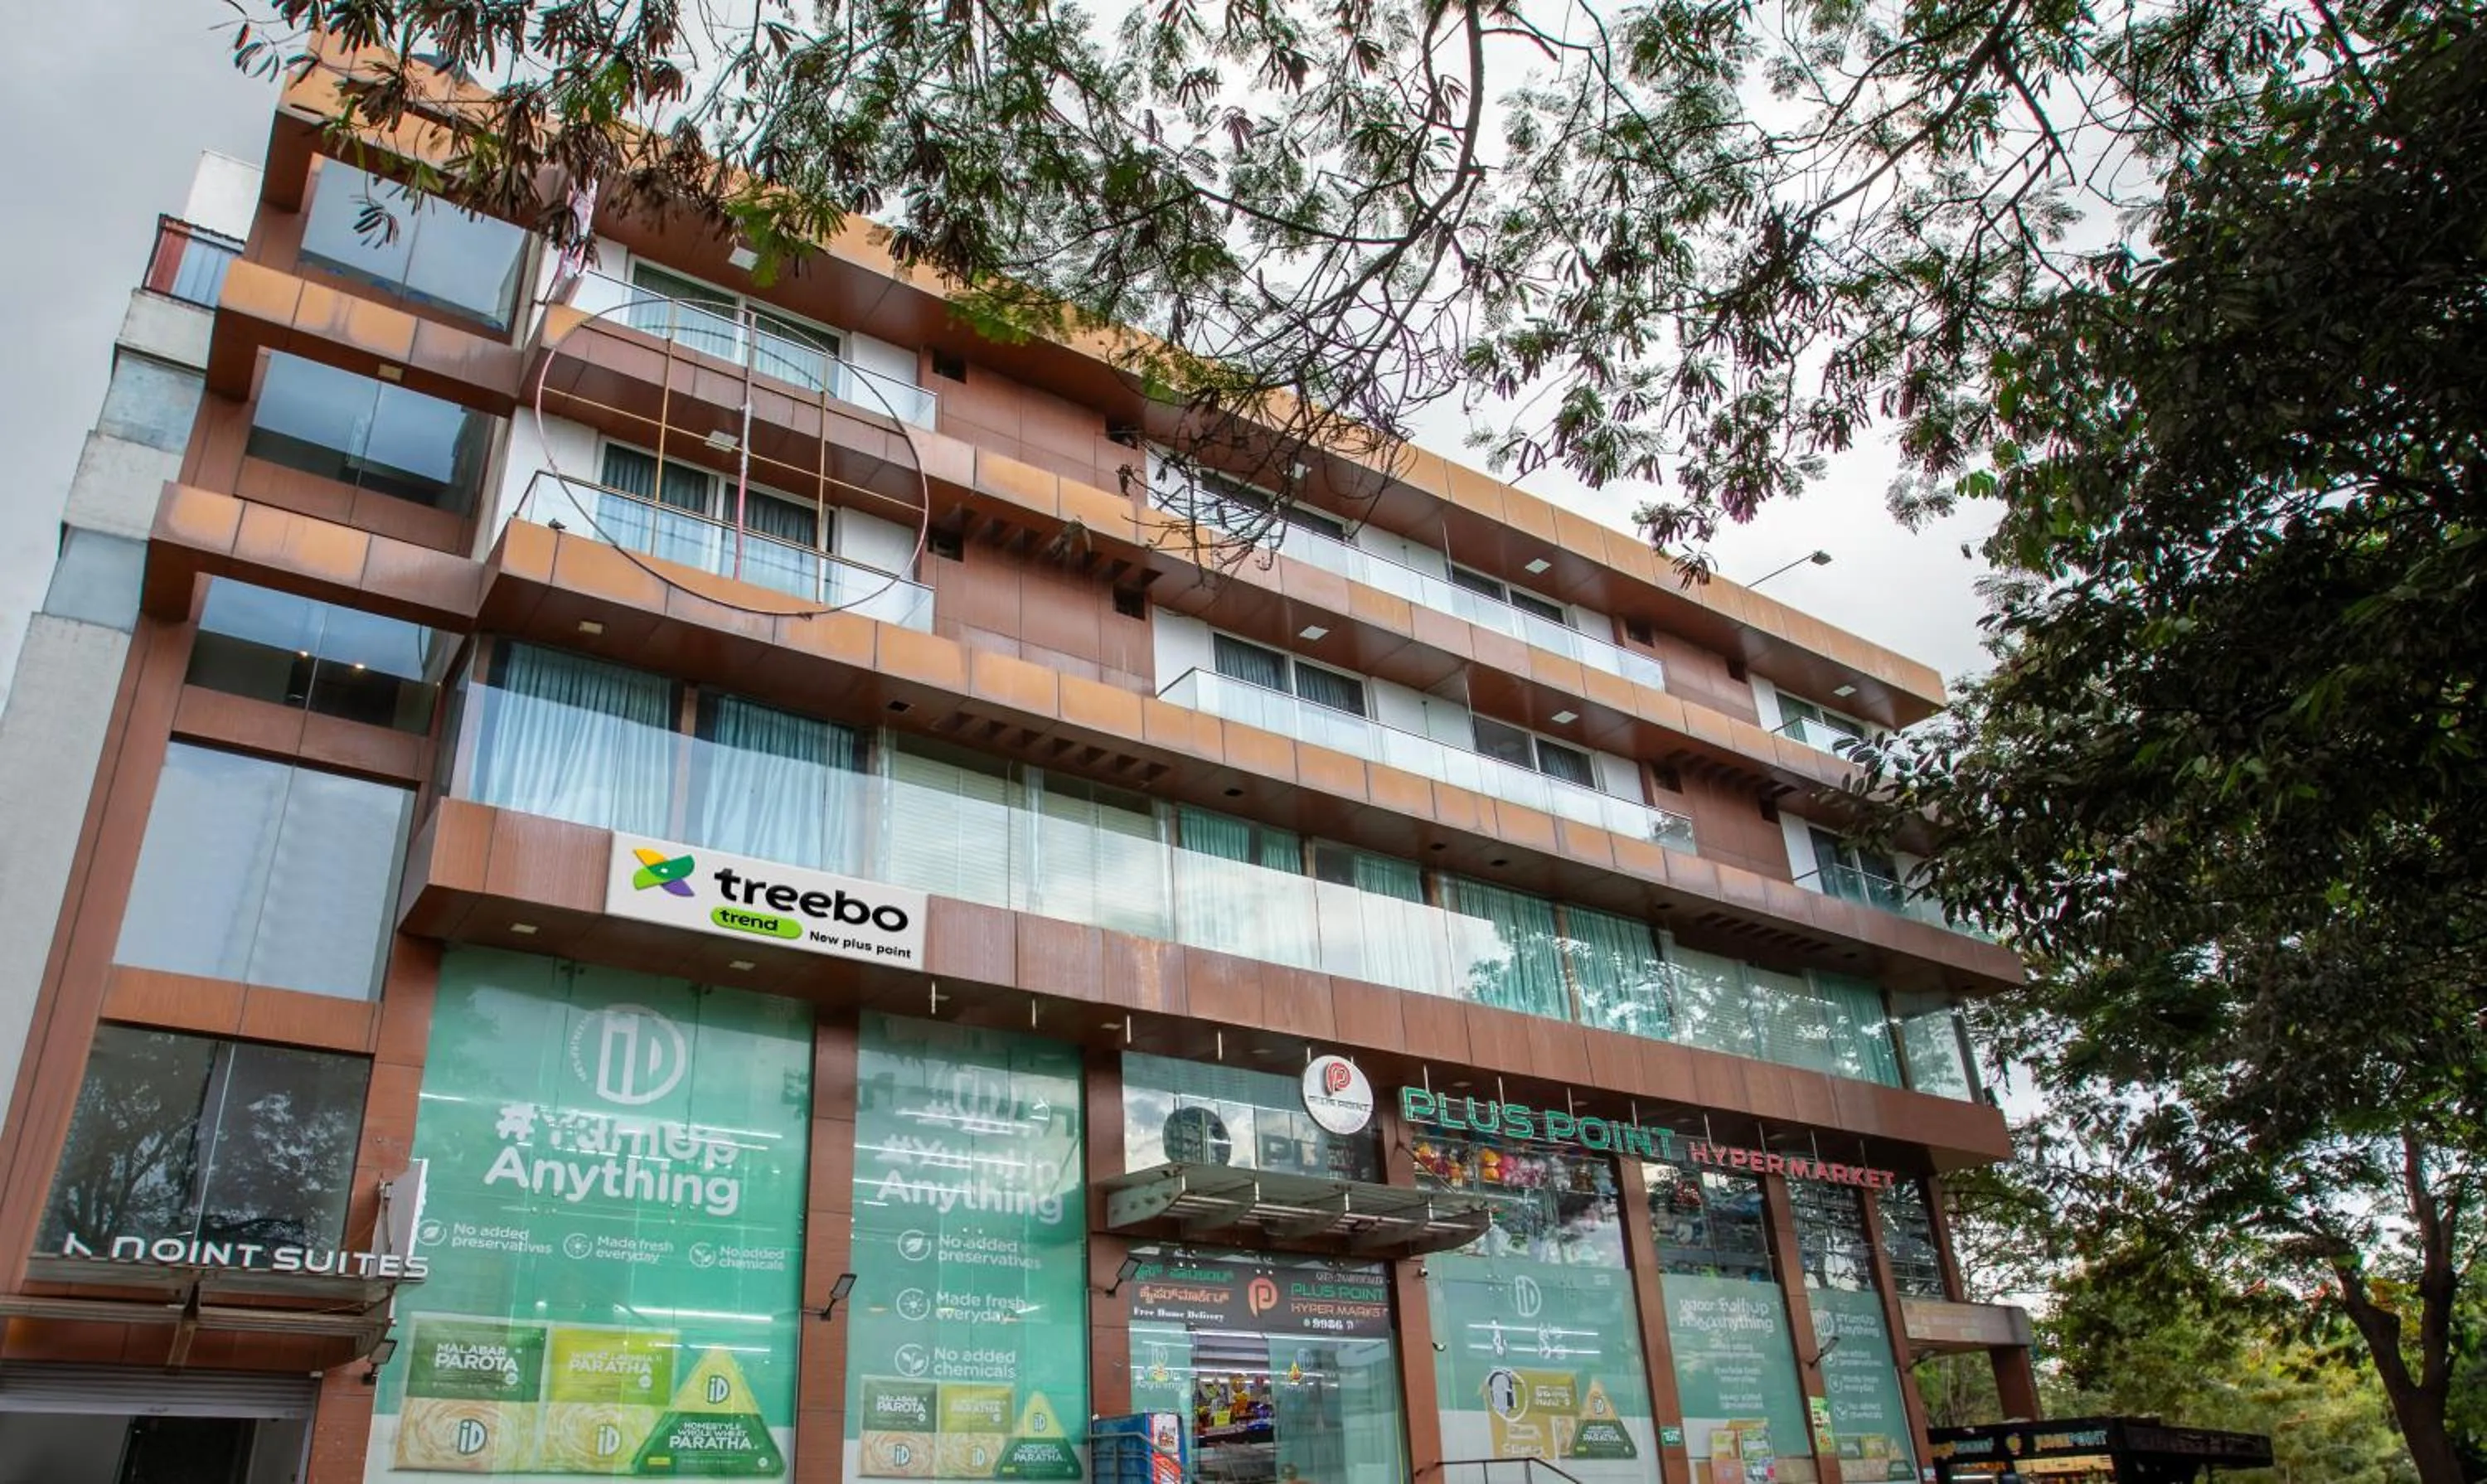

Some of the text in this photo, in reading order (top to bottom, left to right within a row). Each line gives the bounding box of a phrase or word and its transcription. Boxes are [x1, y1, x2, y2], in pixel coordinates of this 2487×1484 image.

[715, 868, 909, 933] treebo
[720, 909, 778, 932] trend
[810, 930, 912, 959] New plus point
[1401, 1086, 1675, 1160] PLUS POINT
[483, 1147, 739, 1215] Anything
[877, 1169, 1063, 1225] Anything
[453, 1223, 530, 1240] No added
[452, 1236, 553, 1254] preservatives
[598, 1235, 674, 1253] Made fresh
[939, 1234, 1018, 1253] No added
[272, 1246, 429, 1279] SUITES
[596, 1249, 661, 1264] everyday
[718, 1257, 786, 1270] chemicals
[740, 1248, 786, 1260] added
[938, 1249, 1041, 1269] preservatives
[936, 1290, 1026, 1310] Made fresh
[1291, 1283, 1384, 1301] PLUS POINT
[936, 1307, 1011, 1324] everyday
[437, 1343, 507, 1355] MALABAR
[934, 1346, 1016, 1364] No added
[434, 1353, 518, 1373] PAROTA
[934, 1360, 1016, 1379] chemicals
[669, 1435, 753, 1450] PARATHA
